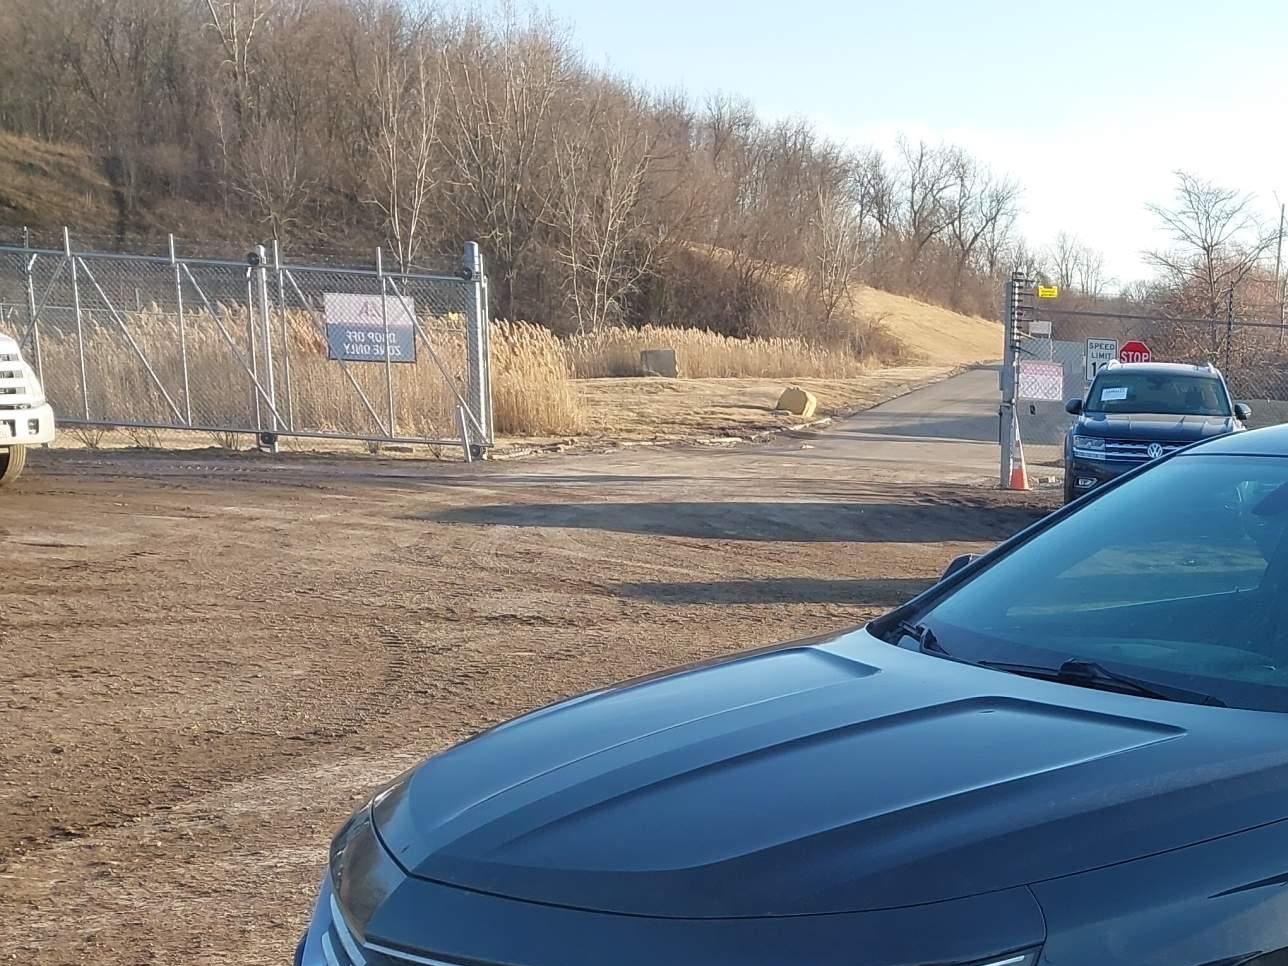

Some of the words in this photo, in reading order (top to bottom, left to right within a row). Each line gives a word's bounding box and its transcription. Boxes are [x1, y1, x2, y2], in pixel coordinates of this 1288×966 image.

[1088, 342, 1115, 351] SPEED
[1091, 352, 1112, 360] LIMIT
[1120, 351, 1149, 363] STOP
